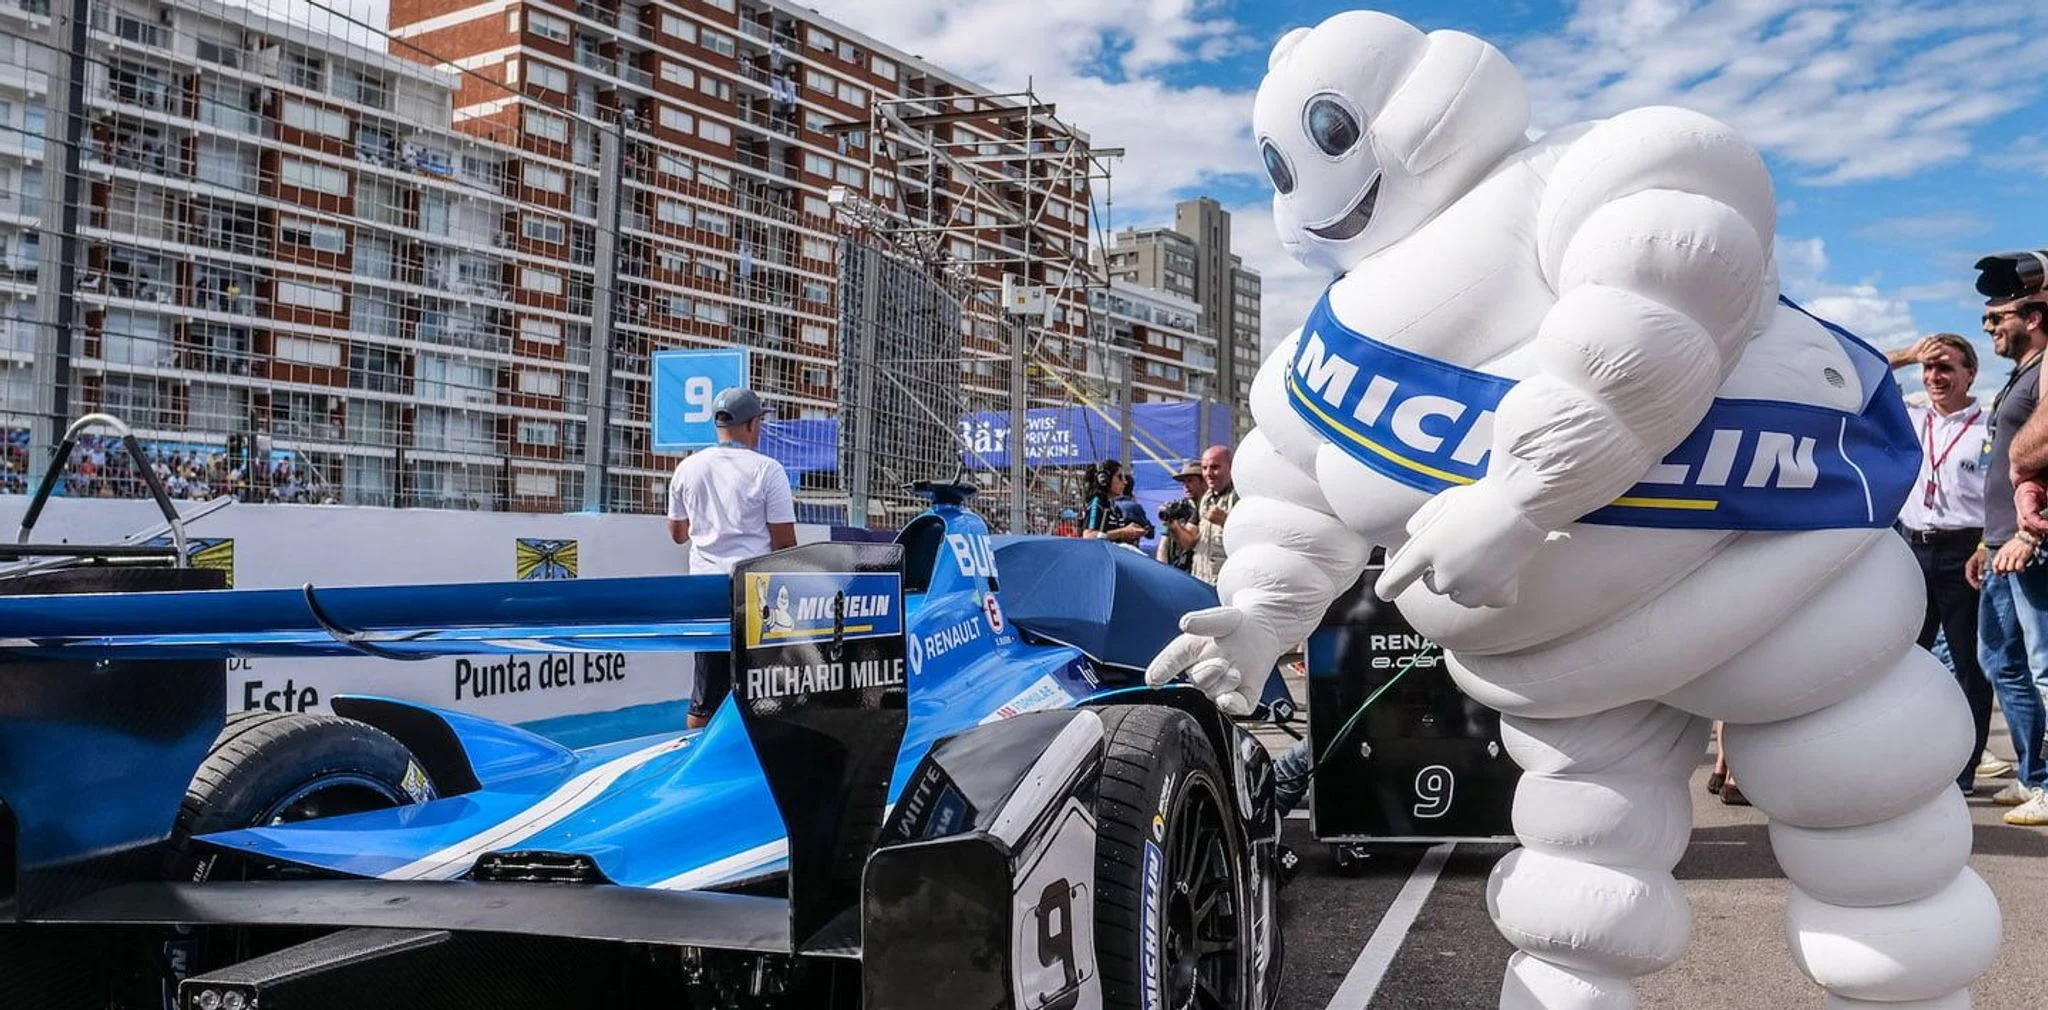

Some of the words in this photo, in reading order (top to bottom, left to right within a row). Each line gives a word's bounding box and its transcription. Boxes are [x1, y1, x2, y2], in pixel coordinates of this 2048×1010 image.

[684, 376, 713, 423] 9
[924, 616, 981, 661] RENAULT
[243, 679, 319, 713] Este
[455, 654, 531, 700] Punta
[538, 653, 575, 690] del
[583, 652, 626, 684] Este
[747, 663, 844, 700] RICHARD
[850, 658, 904, 689] MILLE
[1414, 765, 1455, 818] 9
[1037, 878, 1080, 1010] 9
